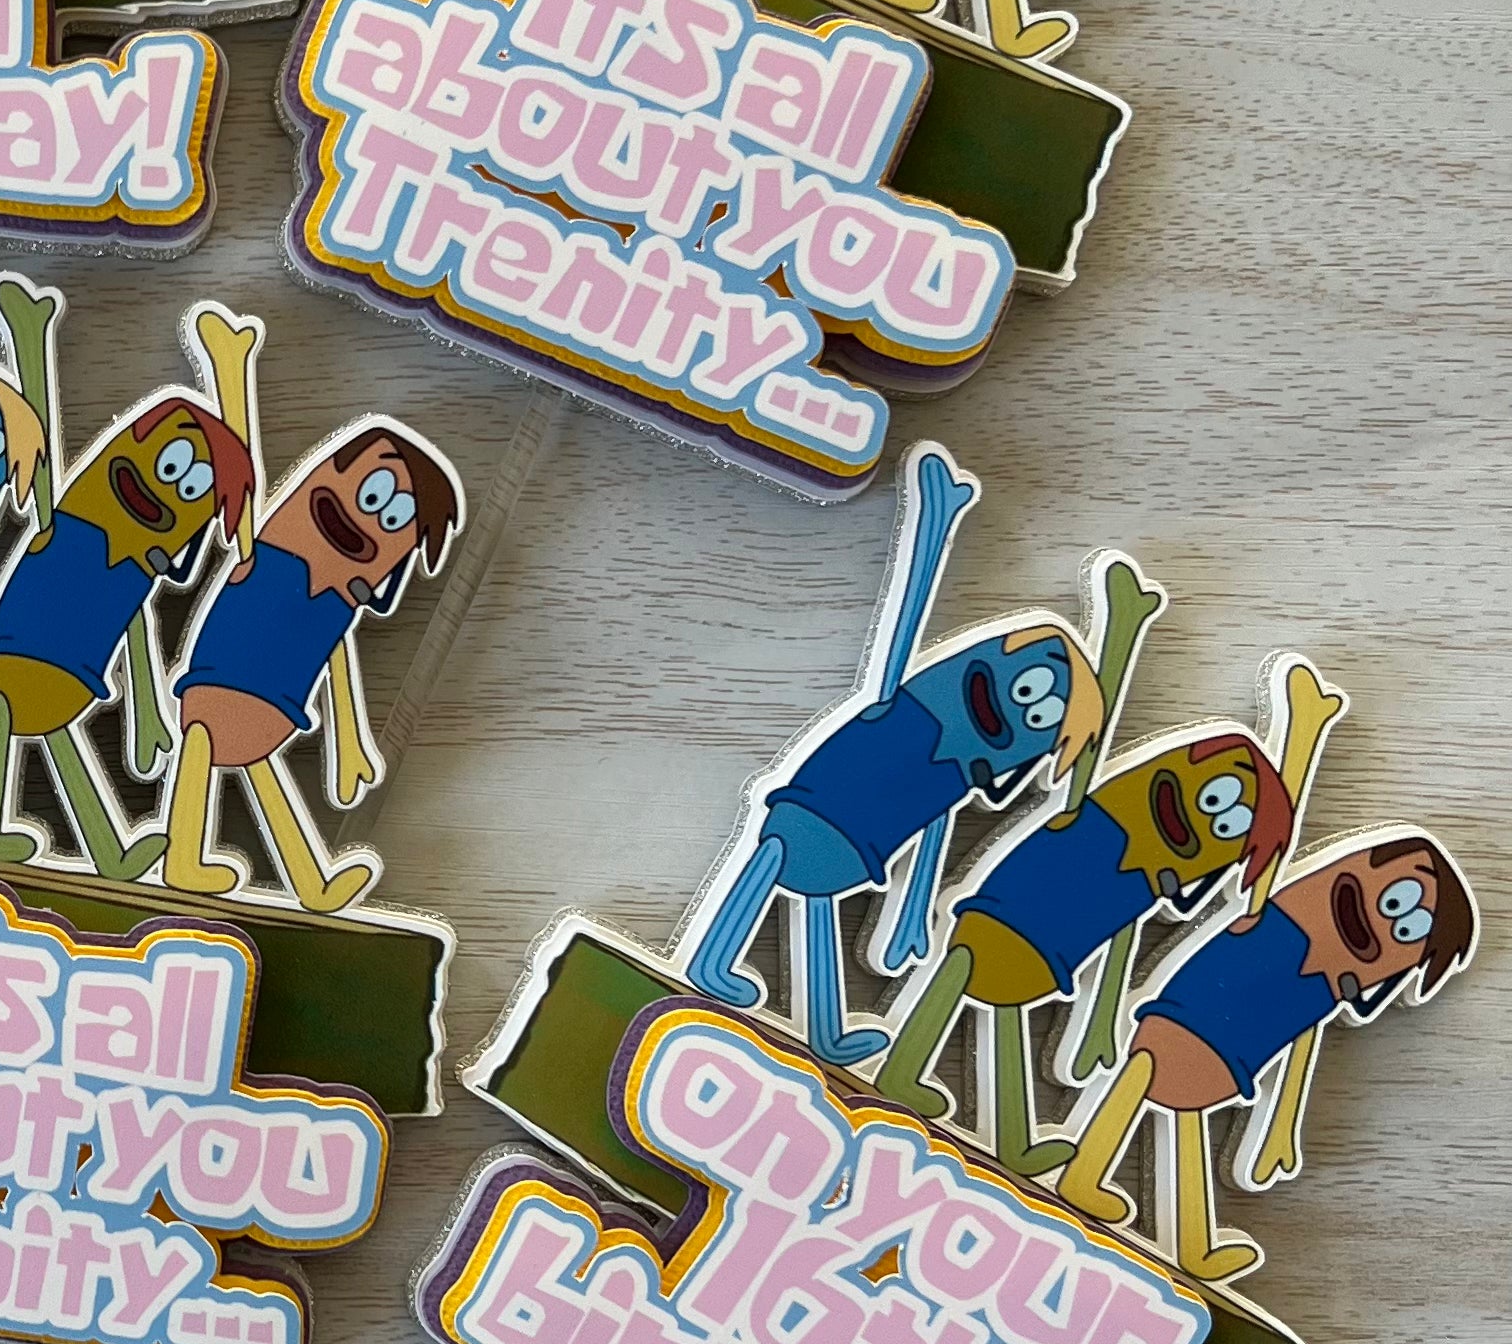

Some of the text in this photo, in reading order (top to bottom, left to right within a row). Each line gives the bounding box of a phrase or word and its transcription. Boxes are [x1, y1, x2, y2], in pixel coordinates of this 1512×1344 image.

[735, 51, 898, 168] all
[337, 12, 986, 326] about you
[346, 125, 860, 437] Trenity...
[75, 967, 219, 1082] all
[95, 1098, 353, 1215] you
